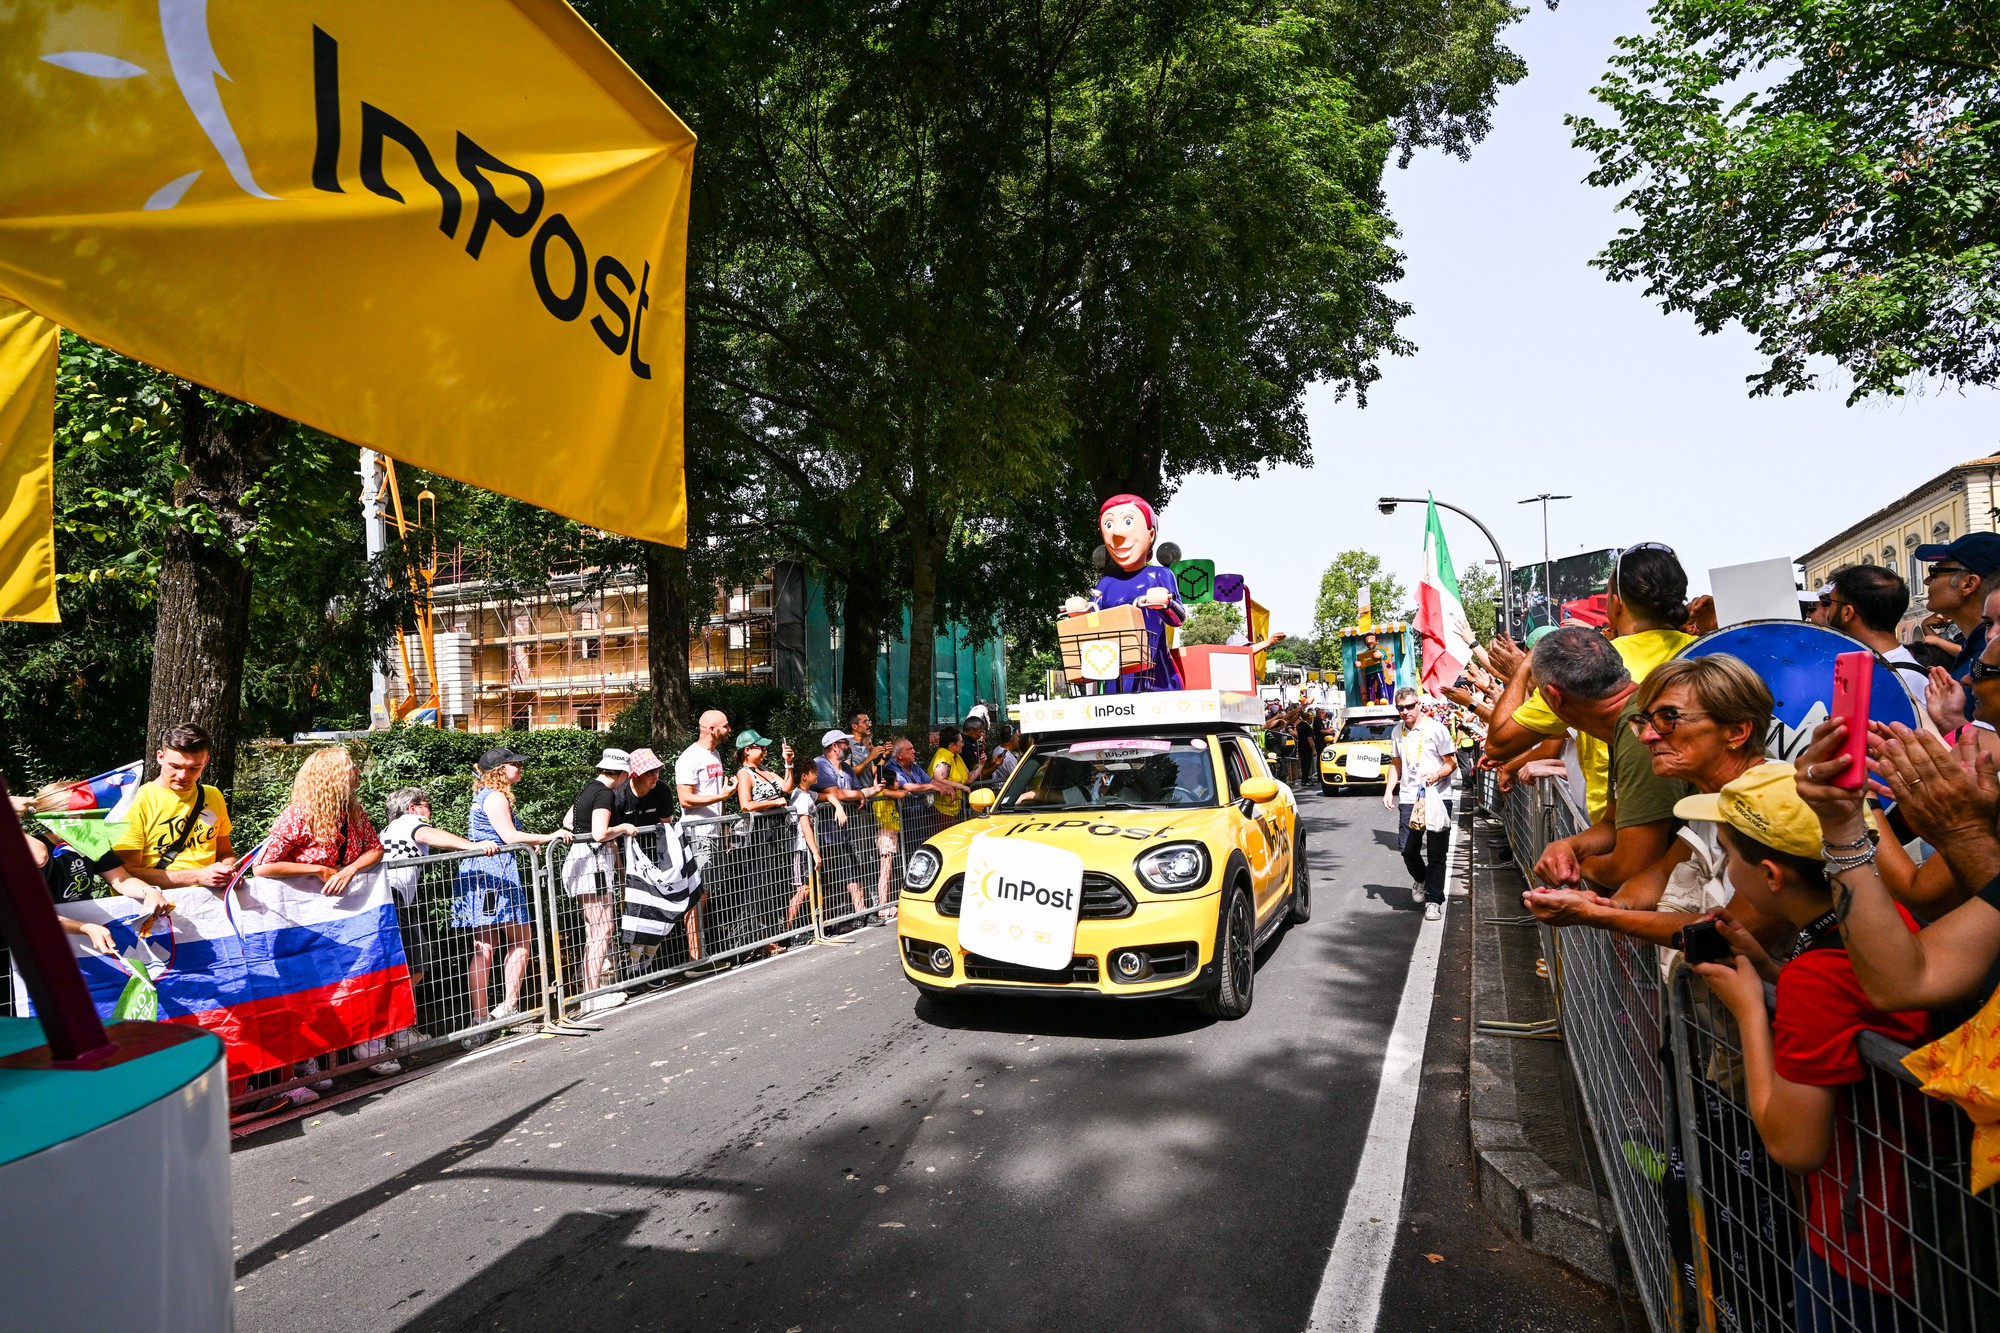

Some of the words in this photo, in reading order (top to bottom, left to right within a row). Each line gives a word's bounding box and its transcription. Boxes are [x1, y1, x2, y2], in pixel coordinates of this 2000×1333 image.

[311, 24, 651, 380] InPost
[1095, 704, 1135, 717] InPost
[1356, 754, 1380, 763] InPost
[1005, 820, 1174, 840] InPost
[997, 876, 1074, 910] InPost
